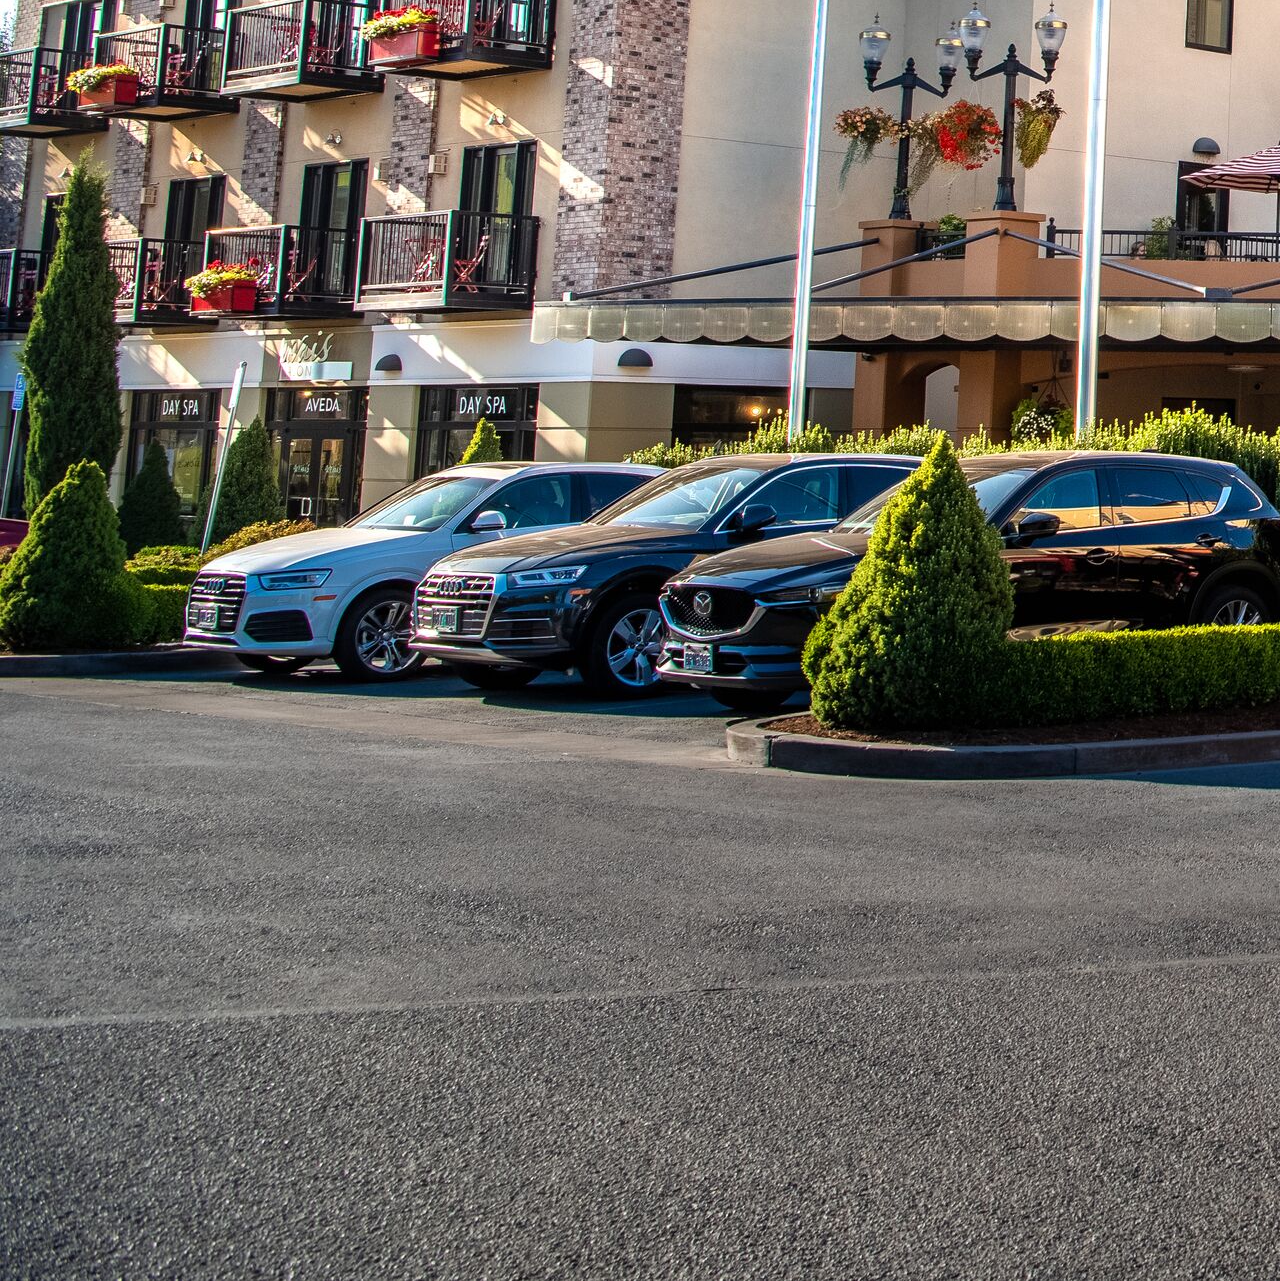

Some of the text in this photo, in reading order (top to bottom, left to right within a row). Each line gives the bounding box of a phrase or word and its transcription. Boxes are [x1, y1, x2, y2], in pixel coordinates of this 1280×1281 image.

[162, 399, 199, 416] DAY SPA
[305, 397, 341, 412] AVEDA
[459, 396, 507, 414] DAY SPA
